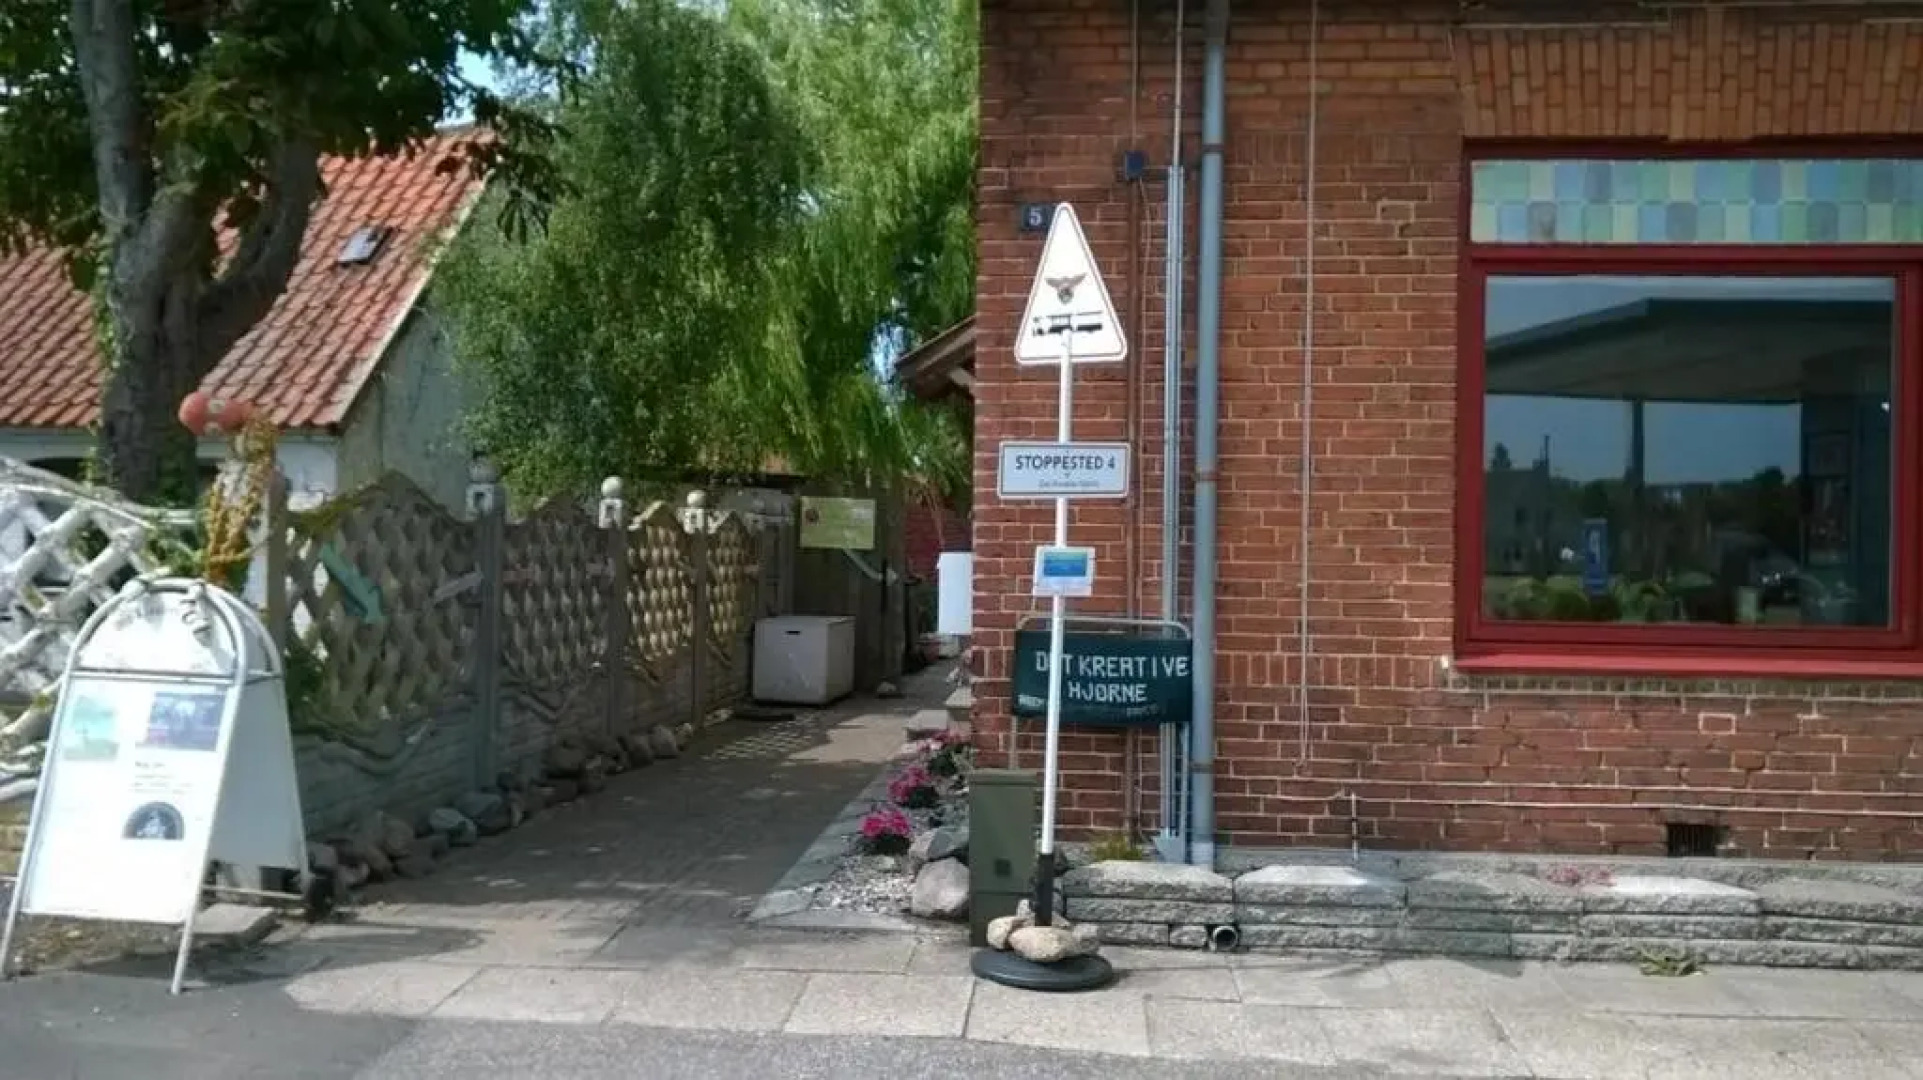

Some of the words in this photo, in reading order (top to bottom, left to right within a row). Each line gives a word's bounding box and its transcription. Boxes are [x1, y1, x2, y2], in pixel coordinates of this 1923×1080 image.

[1028, 208, 1042, 226] 5
[1015, 455, 1103, 471] STOPPESTED
[1107, 456, 1115, 470] 4
[1036, 651, 1073, 675] DT
[1078, 655, 1190, 678] KREATIVE
